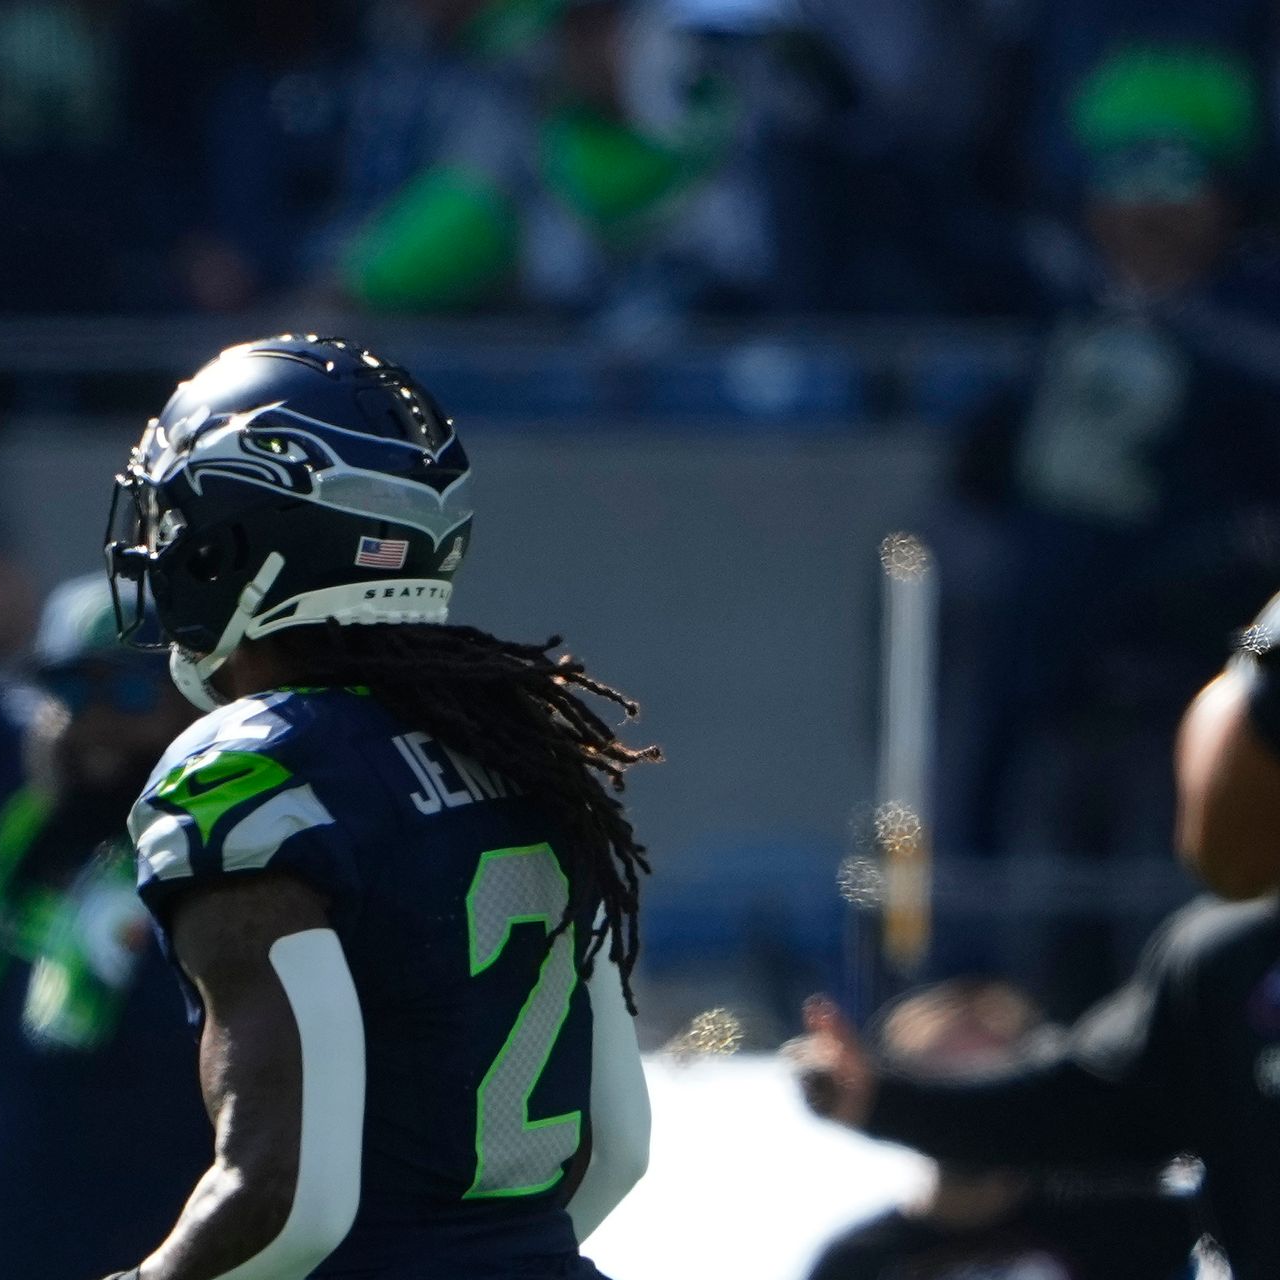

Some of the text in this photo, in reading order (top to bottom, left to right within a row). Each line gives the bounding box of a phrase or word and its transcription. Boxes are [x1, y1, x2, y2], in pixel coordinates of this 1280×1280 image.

[364, 586, 451, 600] SEATTL
[391, 731, 523, 815] JEN
[462, 842, 581, 1199] 2
